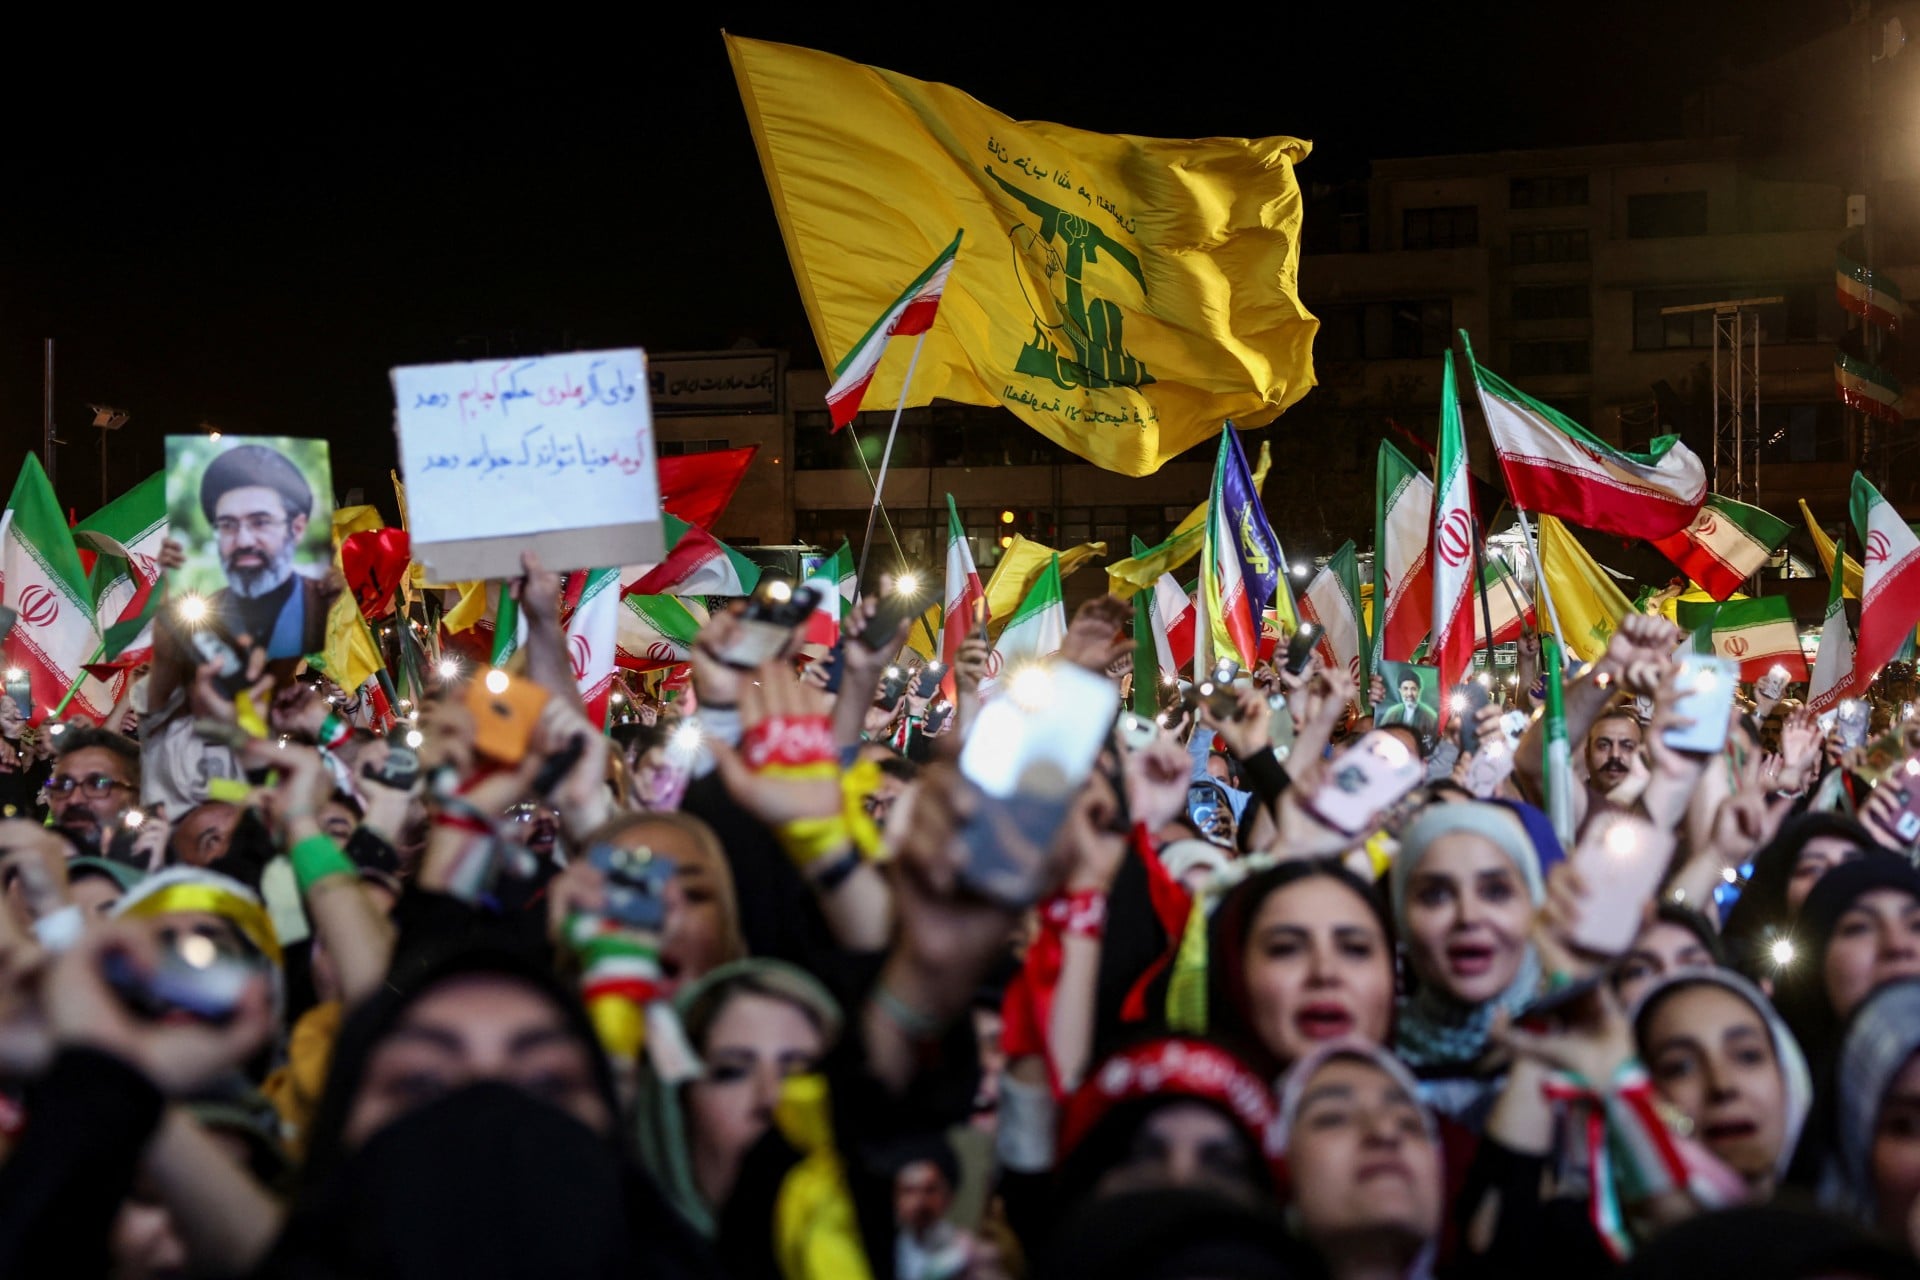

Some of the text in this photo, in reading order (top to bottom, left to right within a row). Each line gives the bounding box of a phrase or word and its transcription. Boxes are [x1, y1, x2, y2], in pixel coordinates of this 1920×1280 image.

[497, 361, 536, 416] حکم
[414, 391, 449, 410] دهد
[420, 454, 459, 473] دهد
